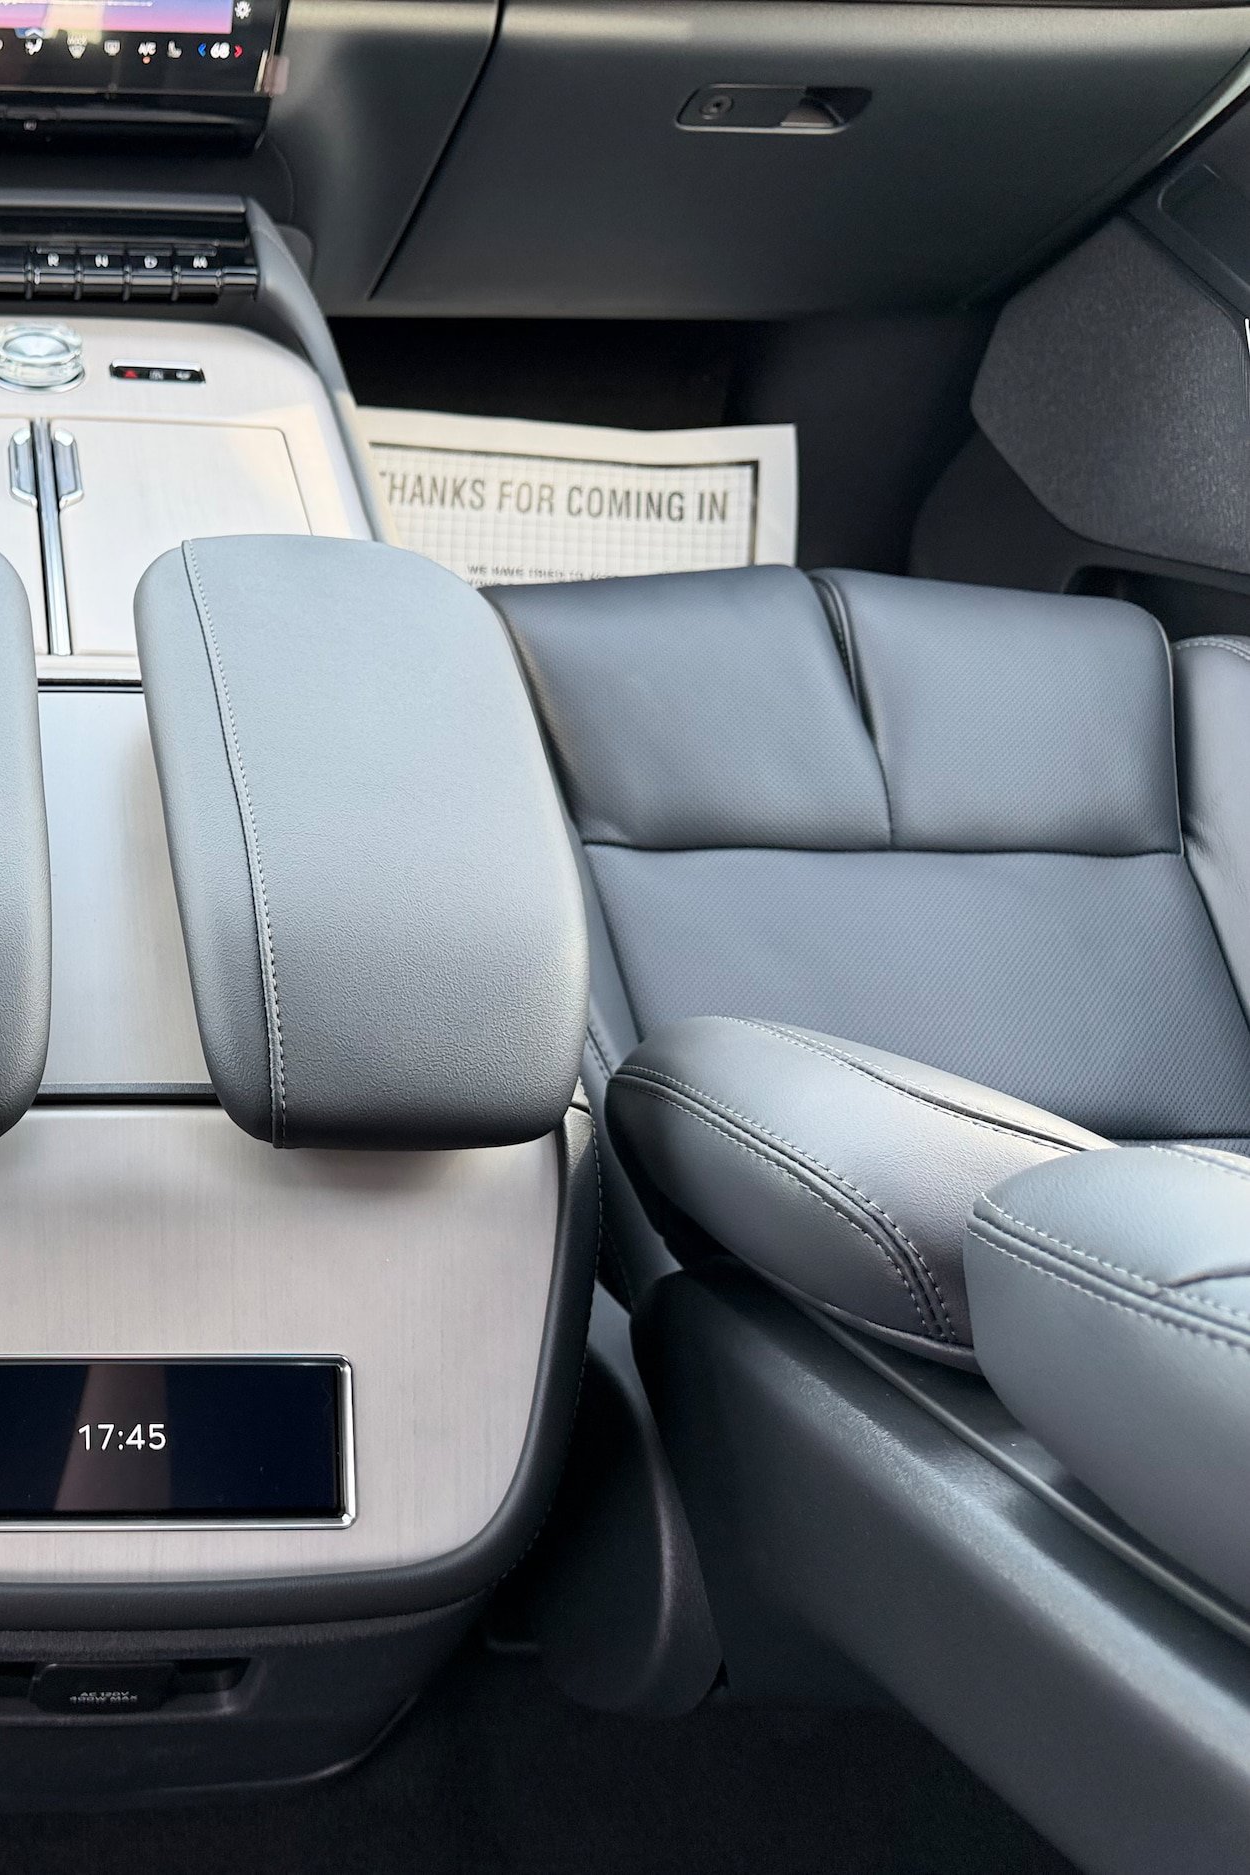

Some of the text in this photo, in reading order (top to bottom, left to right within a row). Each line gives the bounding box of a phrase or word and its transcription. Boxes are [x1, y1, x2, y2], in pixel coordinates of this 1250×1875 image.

[498, 480, 556, 516] FOR
[566, 486, 685, 521] COMING
[698, 491, 729, 523] IN
[468, 564, 487, 576] WE
[78, 1423, 167, 1451] 17:45
